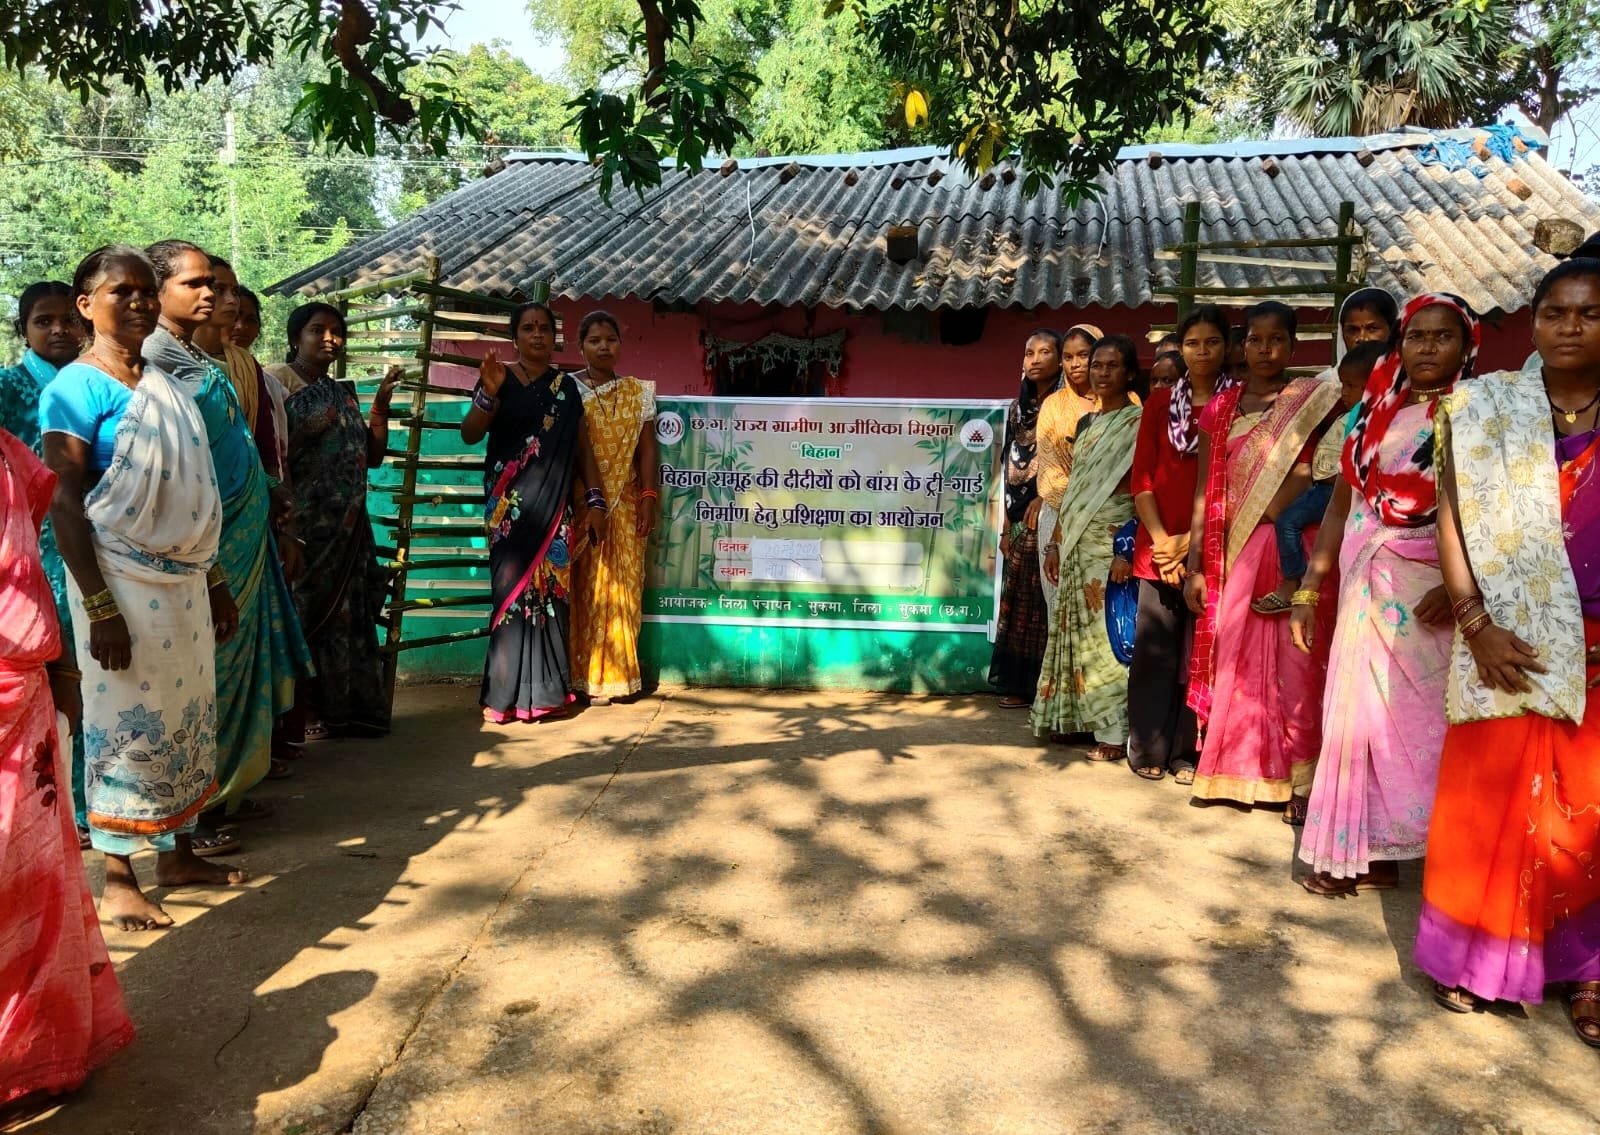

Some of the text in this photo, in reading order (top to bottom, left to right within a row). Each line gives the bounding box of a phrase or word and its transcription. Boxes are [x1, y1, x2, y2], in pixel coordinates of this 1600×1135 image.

[691, 417, 955, 437] छ.ग. राज्य ग्रामीण आजीविका मिशन
[660, 465, 984, 496] बिहान समूह की दीदीयों को बांस के ट्री-गार्ड
[696, 501, 944, 528] निर्माण हेतु प्रशिक्षण का आयोजन
[718, 594, 747, 609] जिला
[752, 596, 792, 611] पंचायत
[852, 598, 882, 614] जिला
[898, 604, 932, 619] सुकमा
